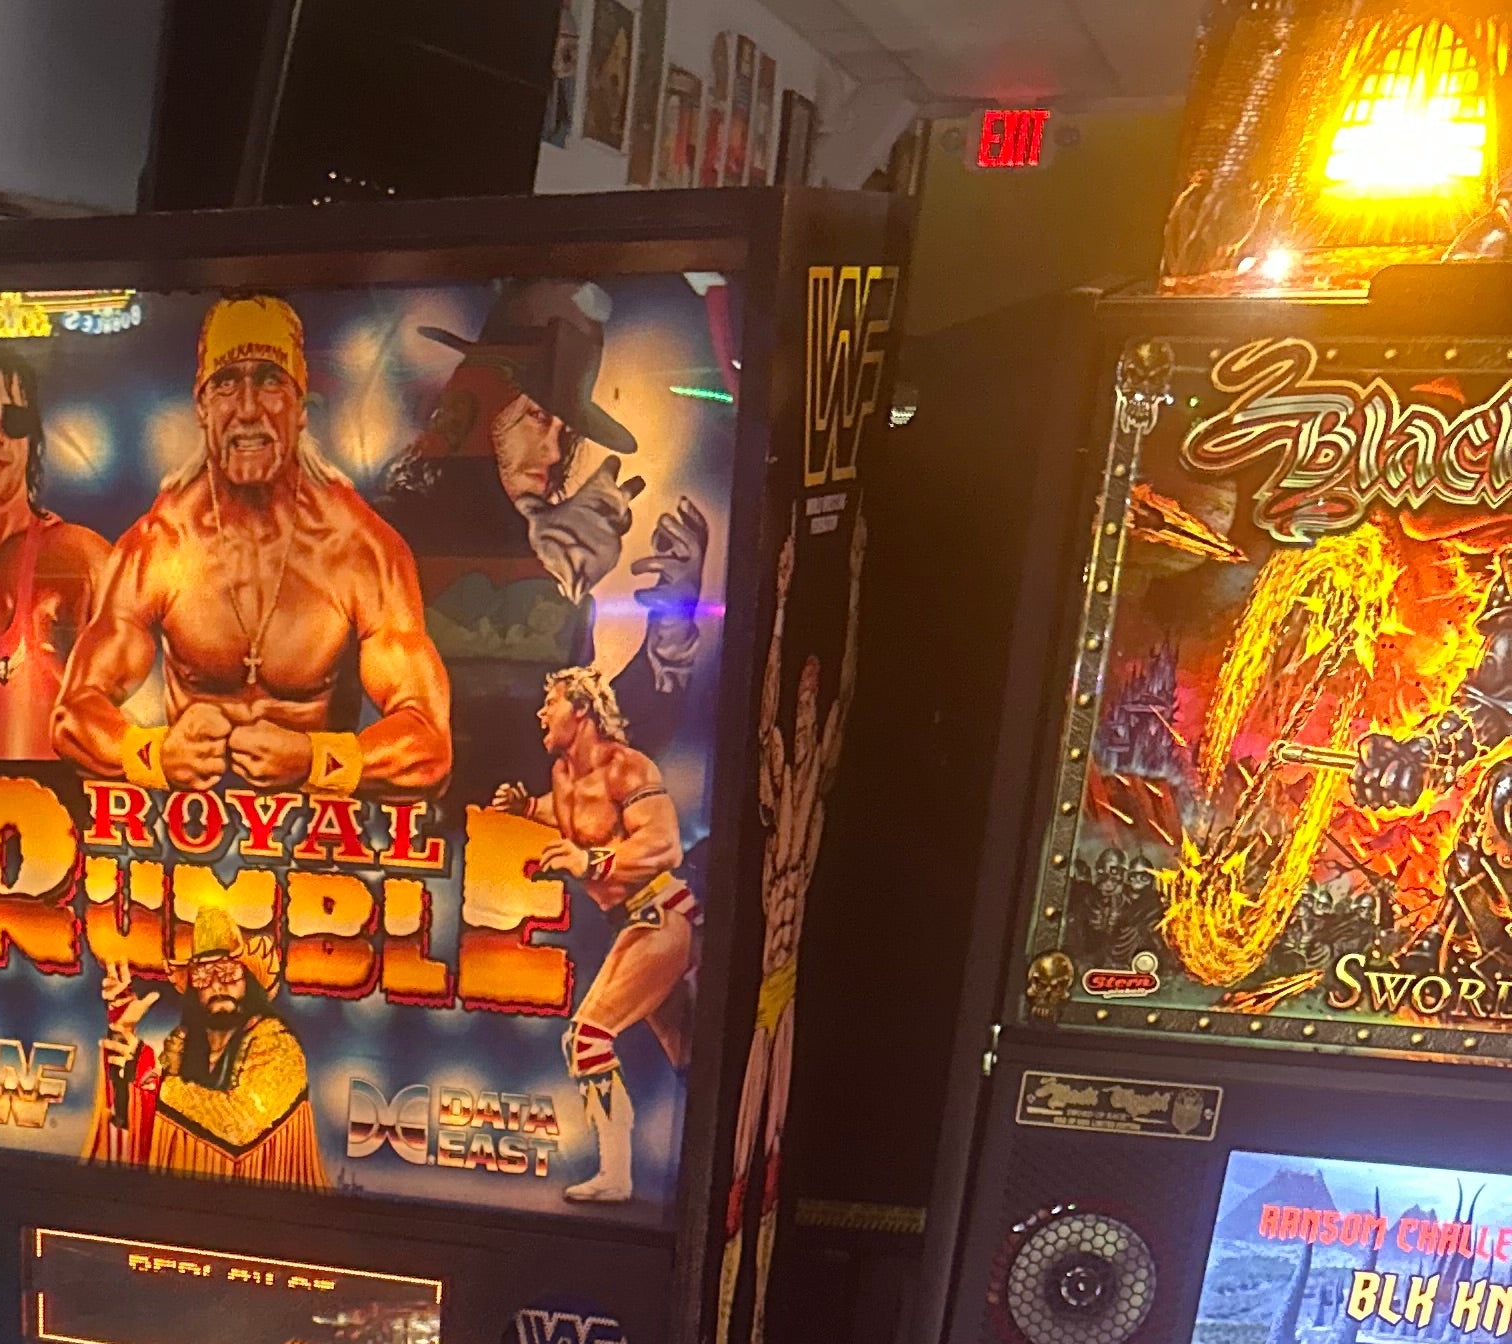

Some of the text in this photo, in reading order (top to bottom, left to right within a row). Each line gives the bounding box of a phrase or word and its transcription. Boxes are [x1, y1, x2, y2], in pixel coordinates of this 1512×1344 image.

[977, 110, 1050, 168] EXIT
[83, 780, 448, 870] ROYAL
[439, 1087, 560, 1135] DATA
[438, 1130, 558, 1177] EAST
[1259, 1204, 1388, 1250] RANSOM
[1347, 1270, 1440, 1328] BLK
